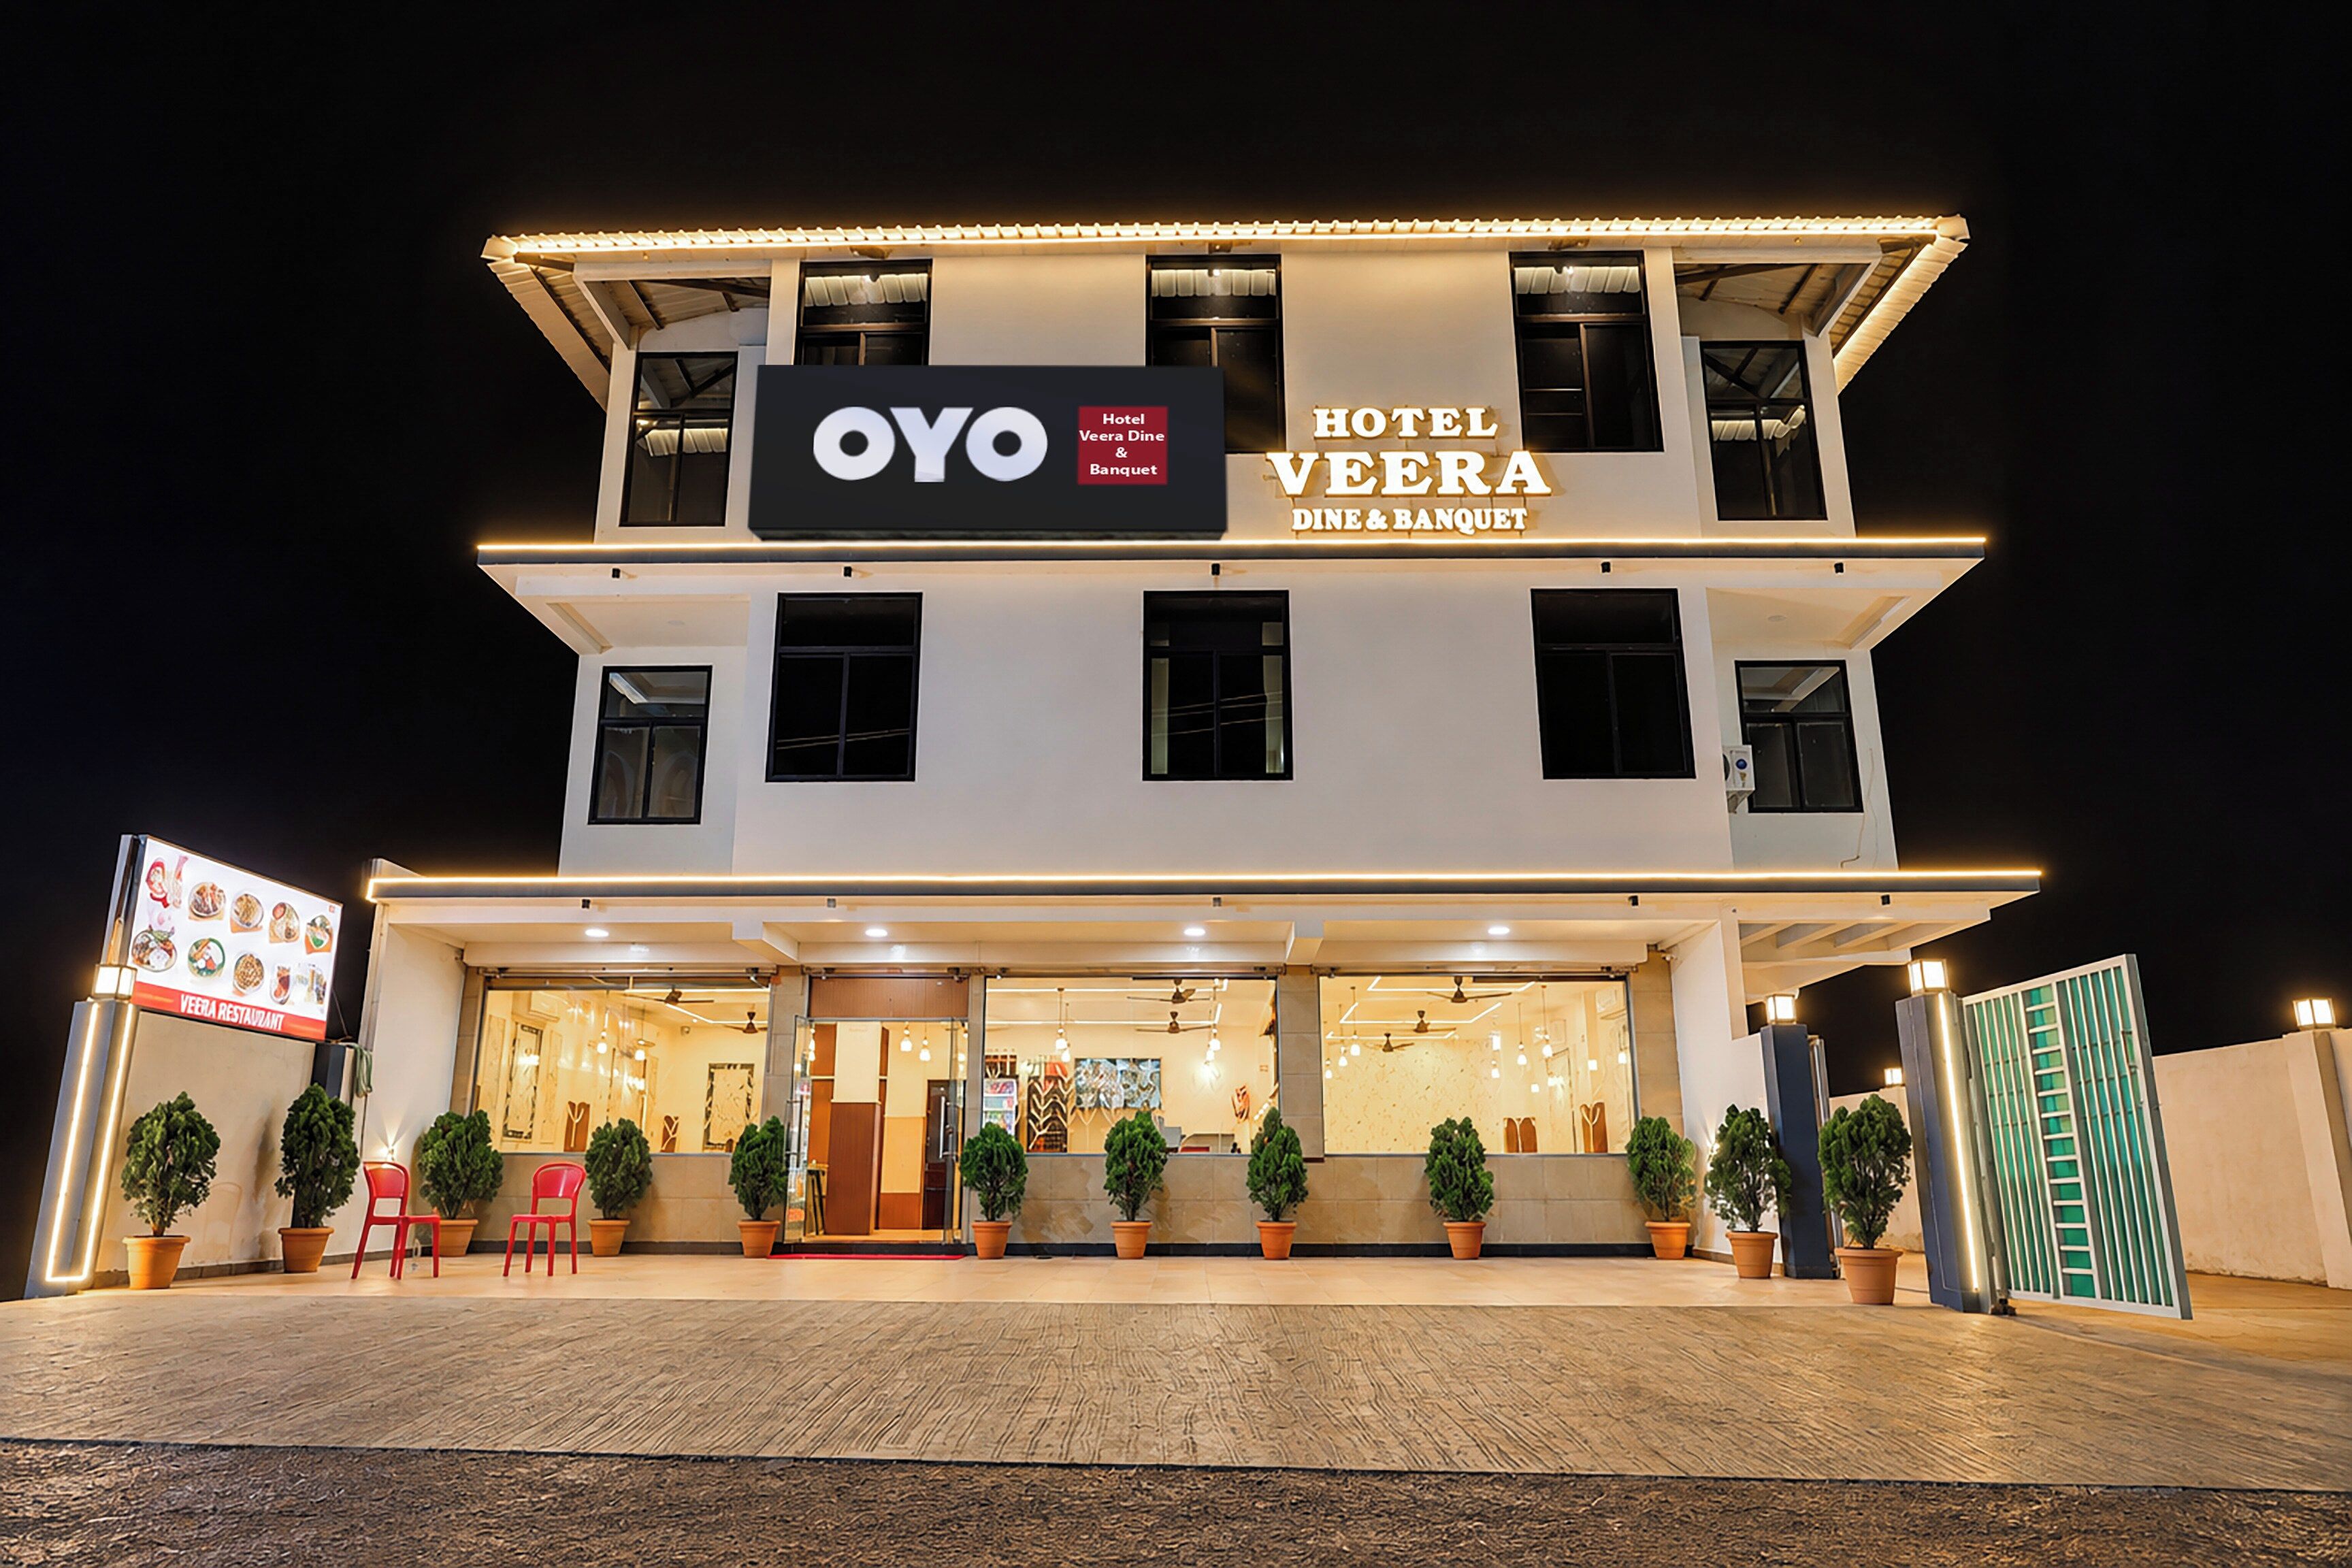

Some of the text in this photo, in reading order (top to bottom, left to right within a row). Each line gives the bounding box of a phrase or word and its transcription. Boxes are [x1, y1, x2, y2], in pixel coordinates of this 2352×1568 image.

[1102, 413, 1145, 425] Hotel
[1313, 407, 1498, 438] HOTEL
[813, 406, 1048, 483] OYO
[1079, 429, 1165, 442] Veera Dine
[1115, 446, 1128, 458] &
[1090, 463, 1158, 477] Banquet
[1266, 450, 1551, 495] VEERA
[1292, 508, 1527, 535] DINE & BANQUET
[180, 994, 284, 1030] VEERA RESTAURANT
